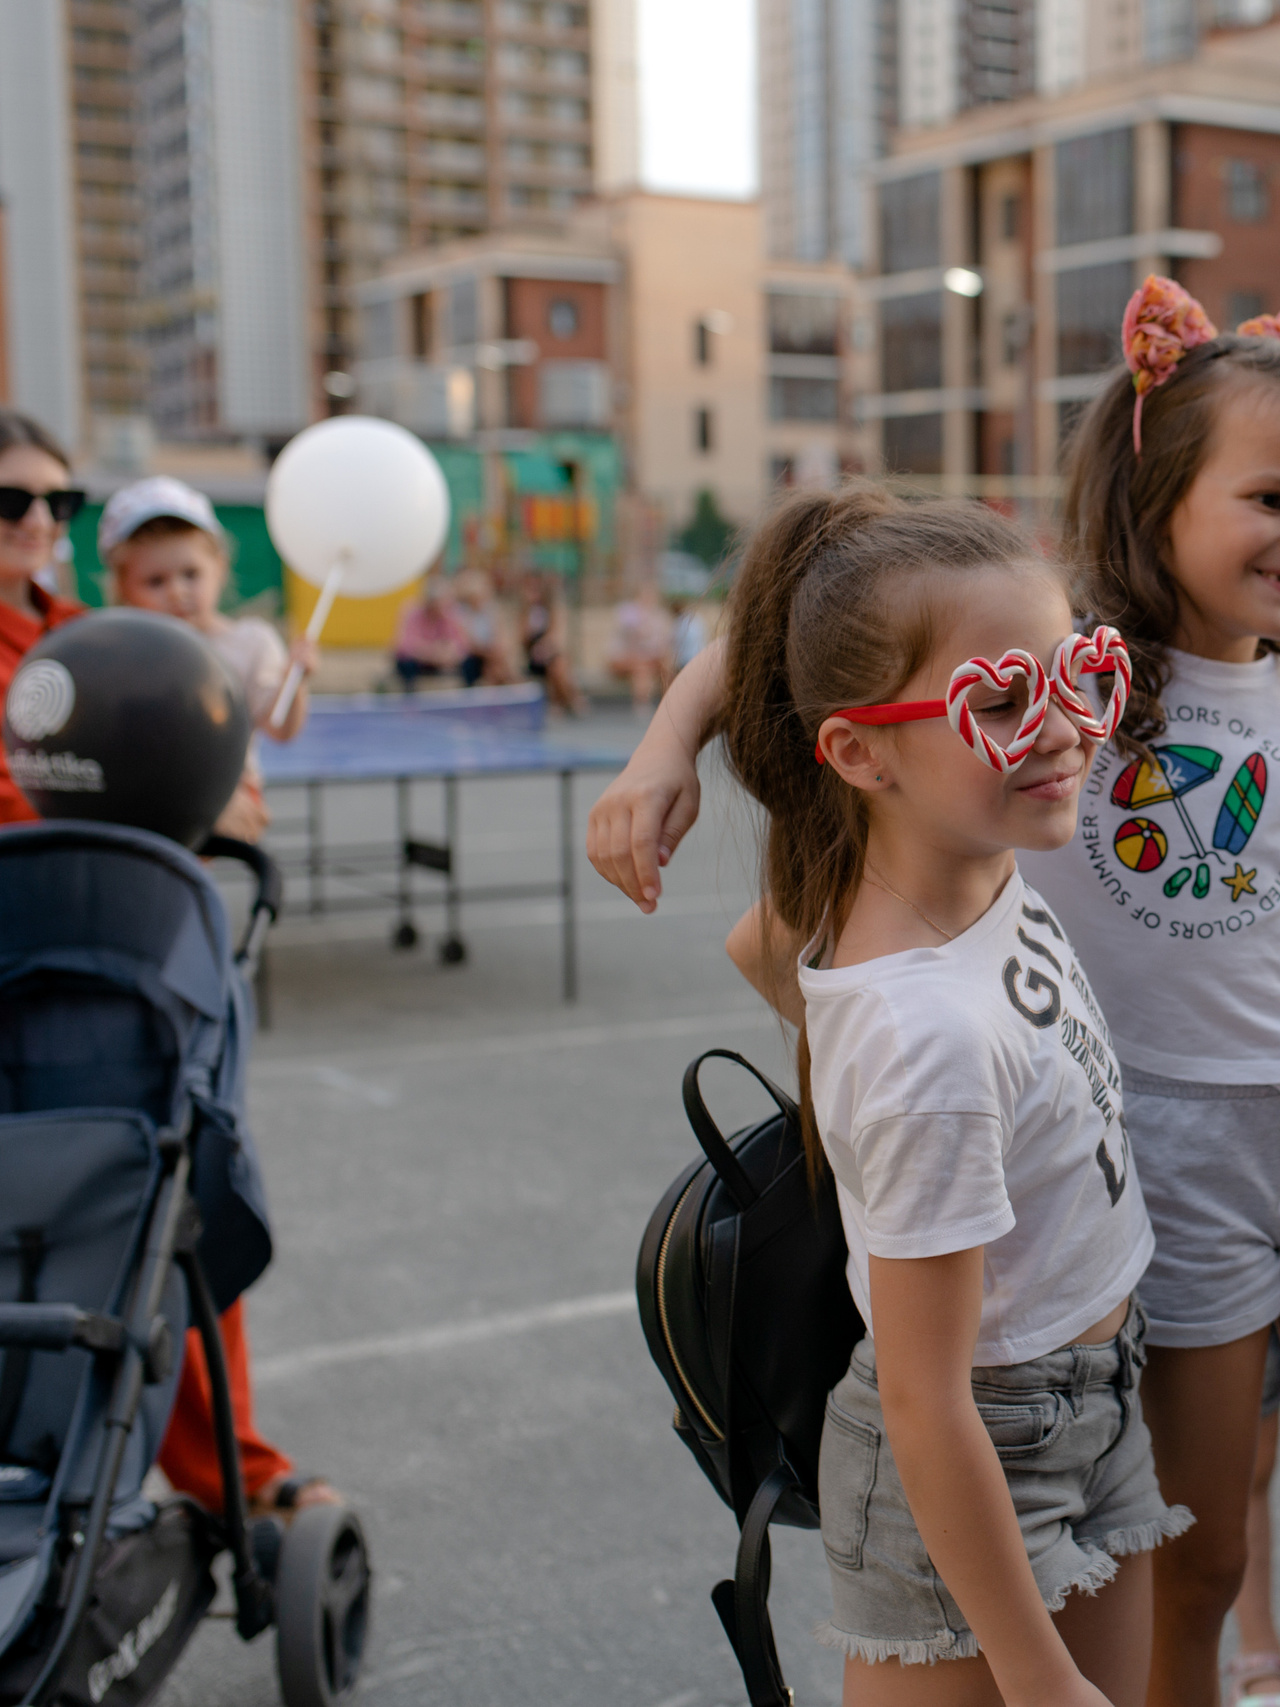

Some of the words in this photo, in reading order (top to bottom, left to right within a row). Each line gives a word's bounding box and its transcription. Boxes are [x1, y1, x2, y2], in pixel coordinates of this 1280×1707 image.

[1086, 741, 1117, 796] UNIT
[1165, 705, 1221, 726] LORS
[1228, 719, 1255, 740] OF
[1082, 815, 1132, 906] SUMMER
[1130, 906, 1161, 929] OF
[1169, 909, 1256, 940] COLORS
